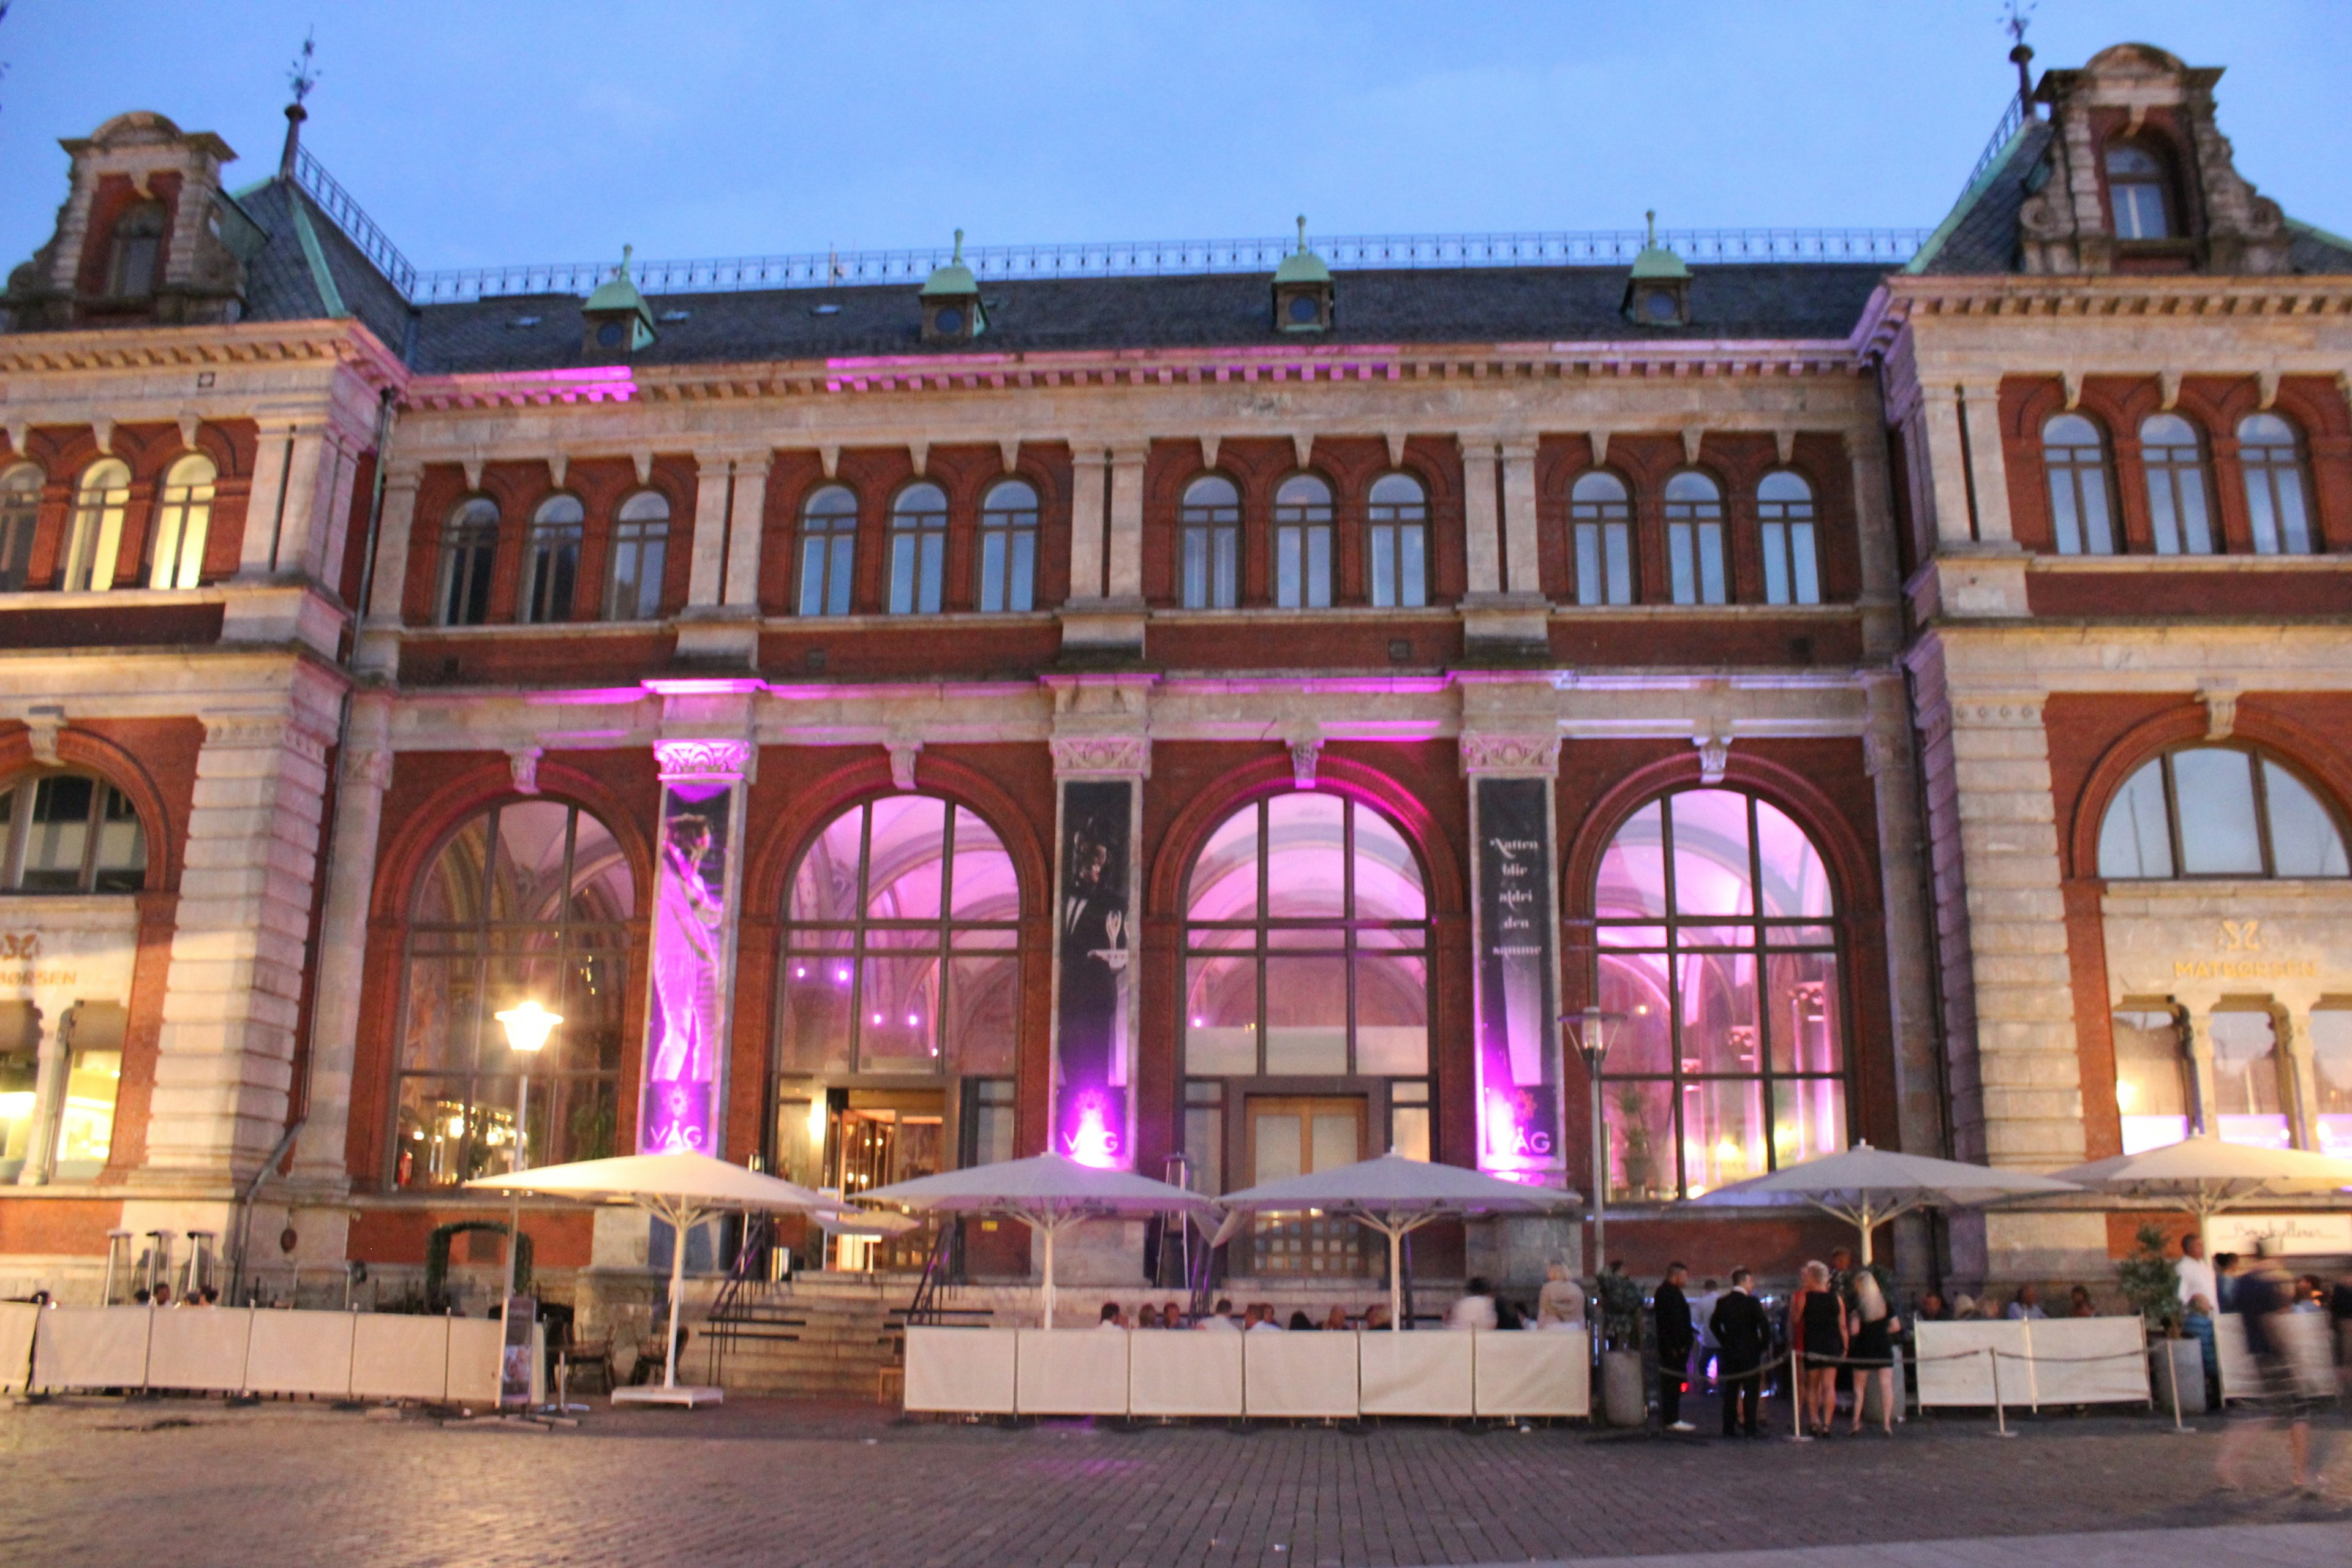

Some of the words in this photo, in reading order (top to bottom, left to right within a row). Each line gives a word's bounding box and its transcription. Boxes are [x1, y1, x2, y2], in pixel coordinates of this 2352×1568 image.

[1502, 863, 1528, 876] blir
[1504, 916, 1530, 929] den
[2174, 960, 2318, 978] MATBØRSEN
[650, 1119, 703, 1148] VÅG
[1063, 1129, 1119, 1153] VG
[1498, 1126, 1551, 1154] ÅG
